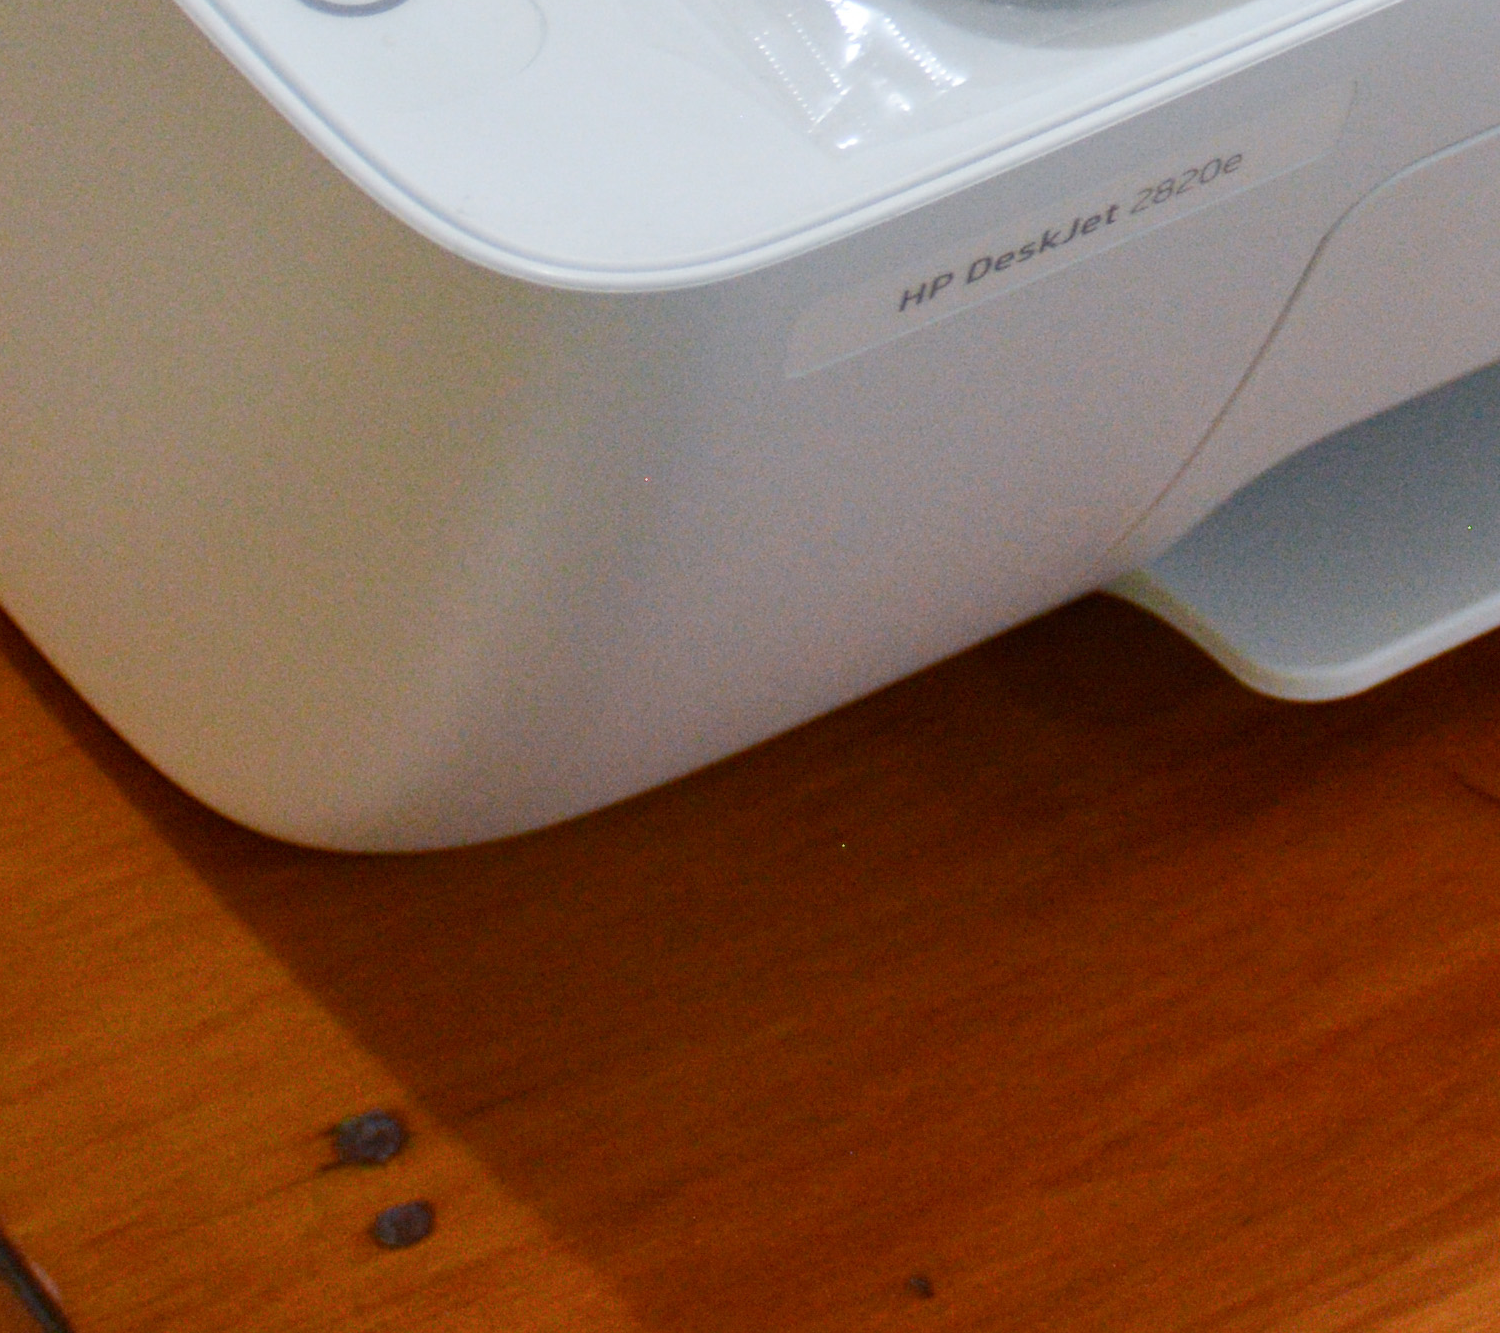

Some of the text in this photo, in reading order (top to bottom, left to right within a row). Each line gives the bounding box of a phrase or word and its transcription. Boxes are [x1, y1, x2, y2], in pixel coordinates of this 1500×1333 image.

[898, 151, 1245, 313] HP DeskJet 2820e
